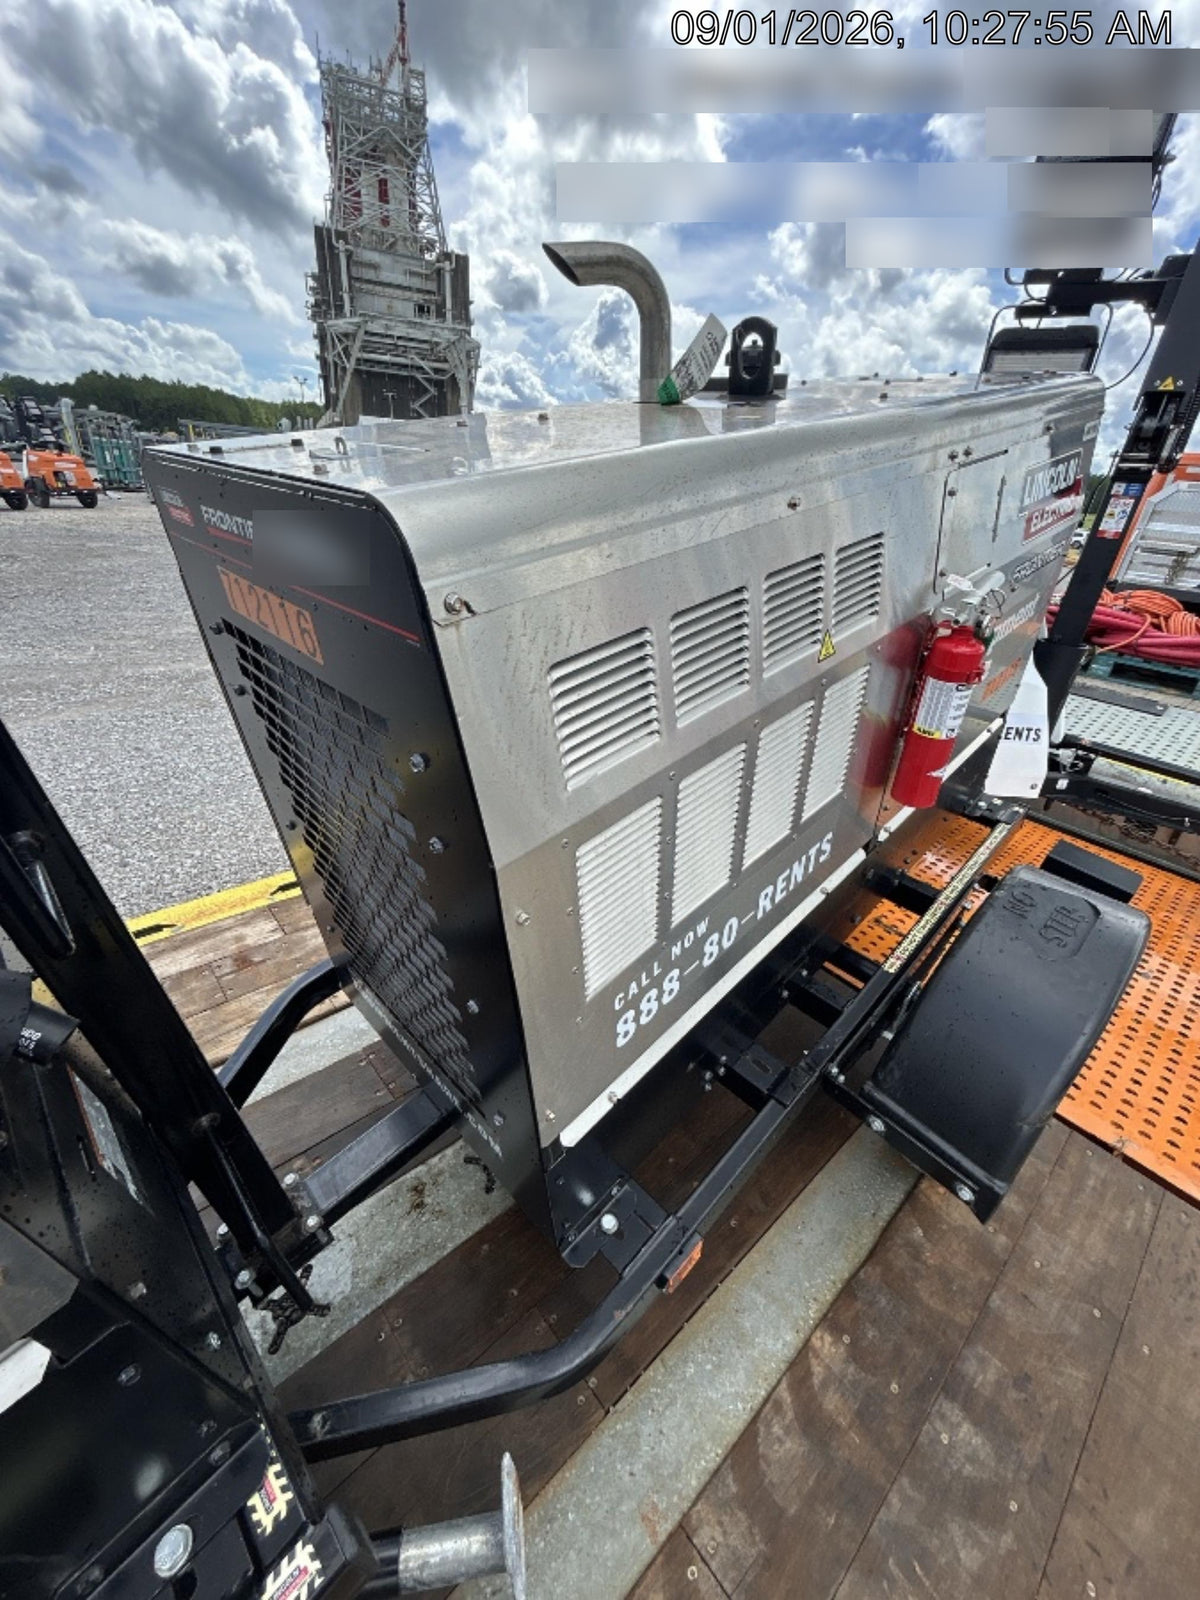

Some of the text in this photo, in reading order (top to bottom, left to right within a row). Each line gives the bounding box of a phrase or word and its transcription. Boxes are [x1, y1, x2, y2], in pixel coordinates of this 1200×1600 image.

[1001, 726, 1041, 742] ENTS
[614, 914, 711, 1011] CALL NOW
[615, 831, 833, 1049] 888-80-RENTS
